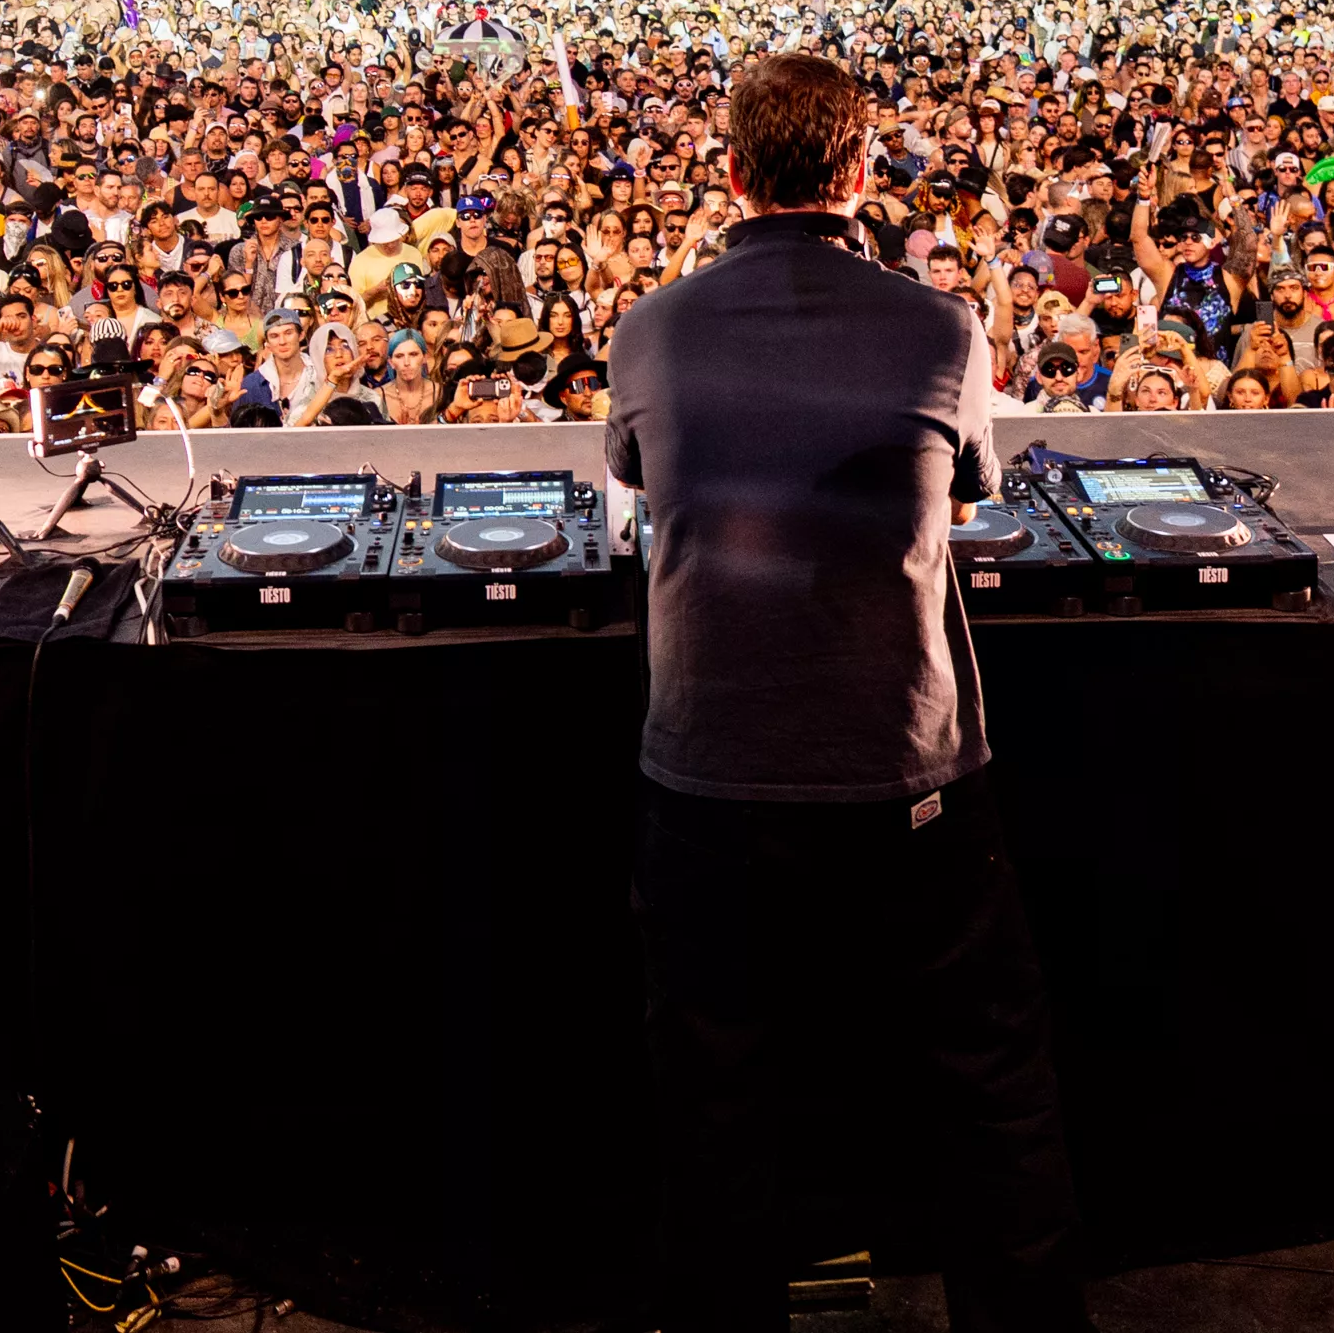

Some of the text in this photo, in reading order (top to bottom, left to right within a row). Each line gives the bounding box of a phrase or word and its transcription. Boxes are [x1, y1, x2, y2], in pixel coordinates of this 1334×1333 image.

[970, 571, 1001, 588] TIËSTO
[1198, 566, 1228, 583] TIËSTO
[259, 586, 291, 603] TIËSTO
[485, 582, 516, 600] TIËSTO
